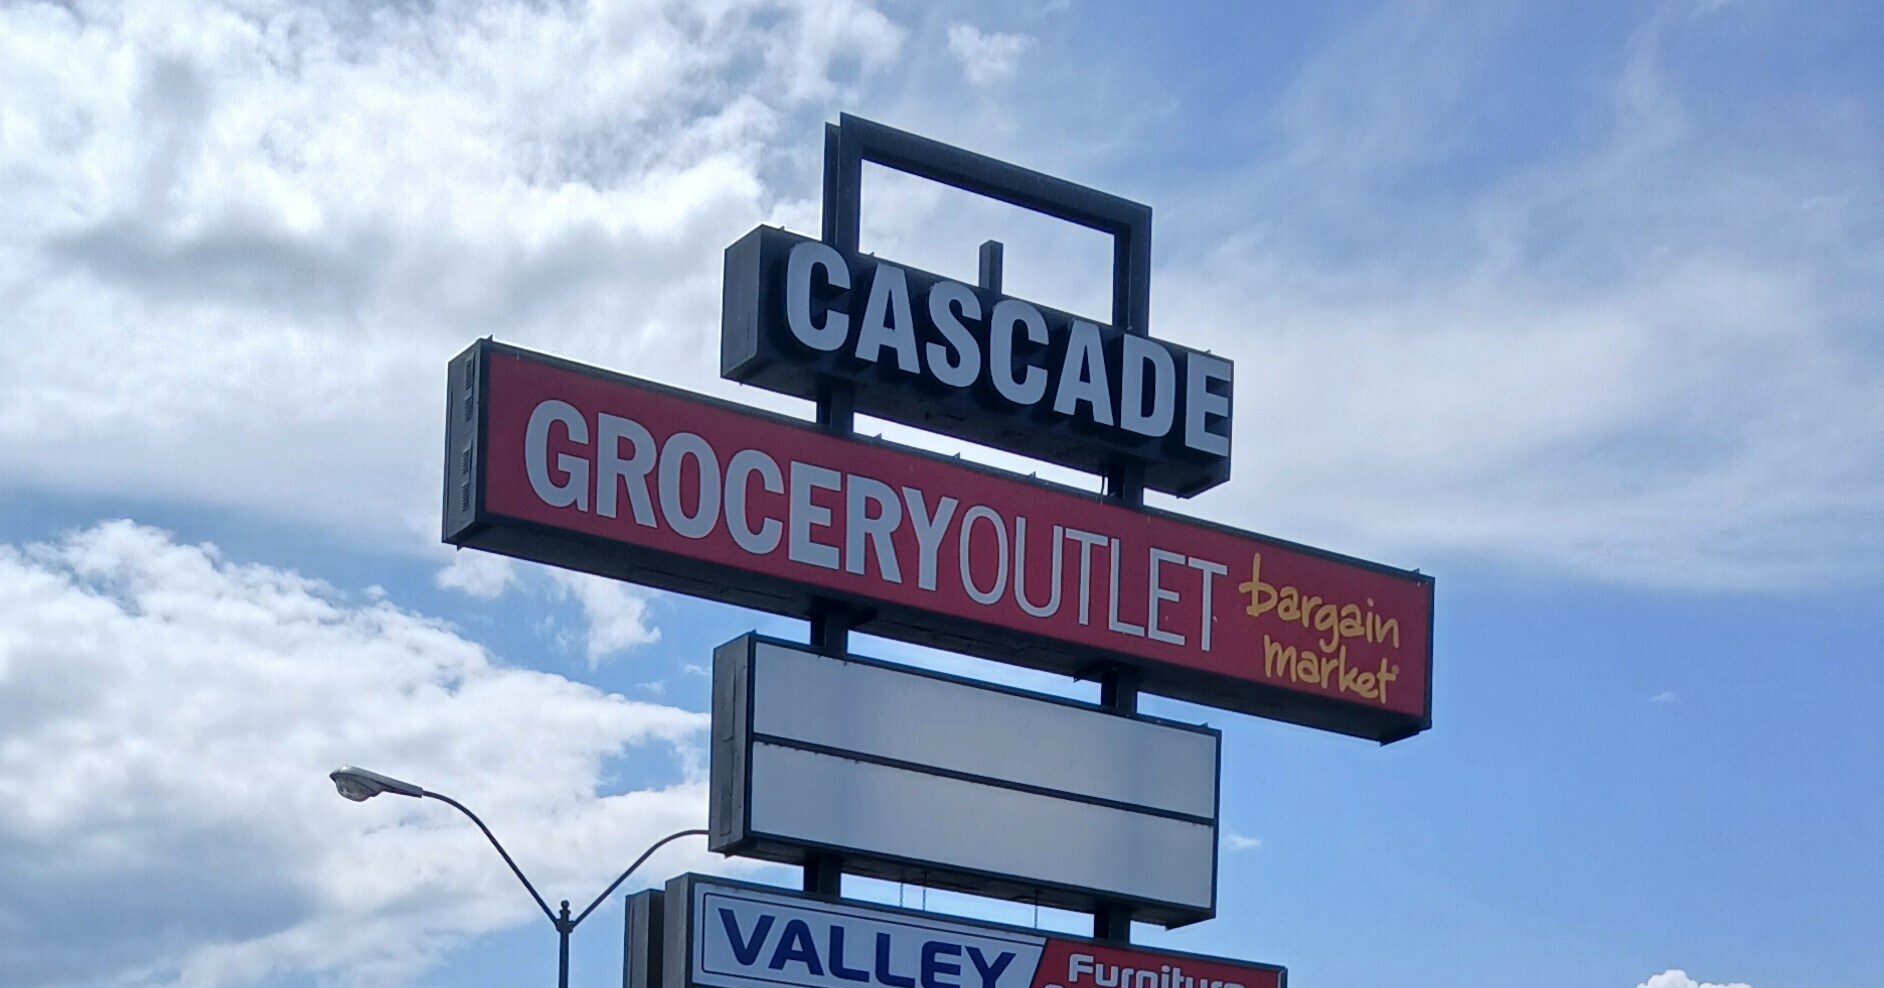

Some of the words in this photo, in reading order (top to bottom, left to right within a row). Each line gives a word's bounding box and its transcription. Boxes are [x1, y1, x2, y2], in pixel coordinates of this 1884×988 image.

[784, 241, 1231, 456] CASCADE
[1238, 552, 1399, 653] bargain
[1263, 634, 1398, 704] market
